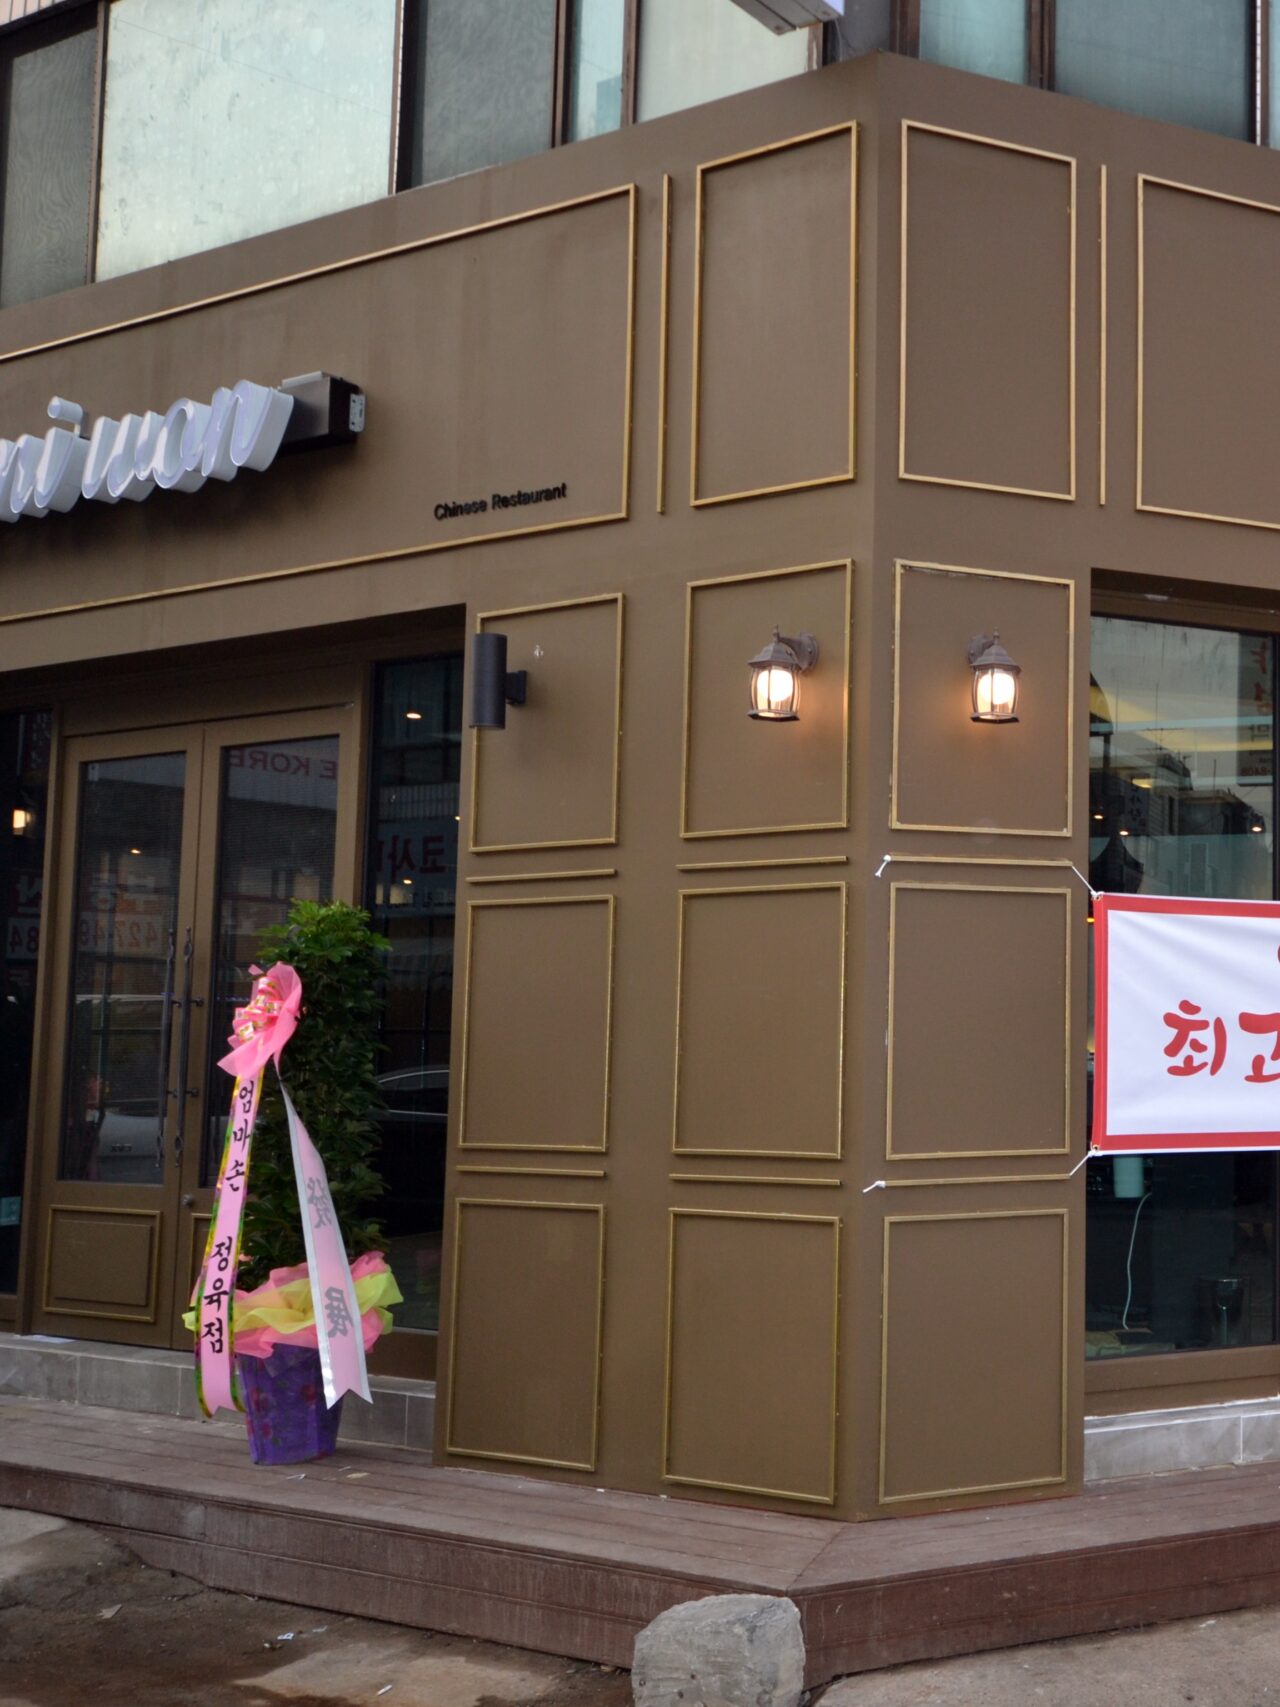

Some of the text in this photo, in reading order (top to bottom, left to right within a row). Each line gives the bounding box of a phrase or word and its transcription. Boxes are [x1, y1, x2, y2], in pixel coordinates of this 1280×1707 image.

[434, 482, 567, 520] Chinese Restaurant
[202, 1080, 255, 1354] 엄마손 정육점
